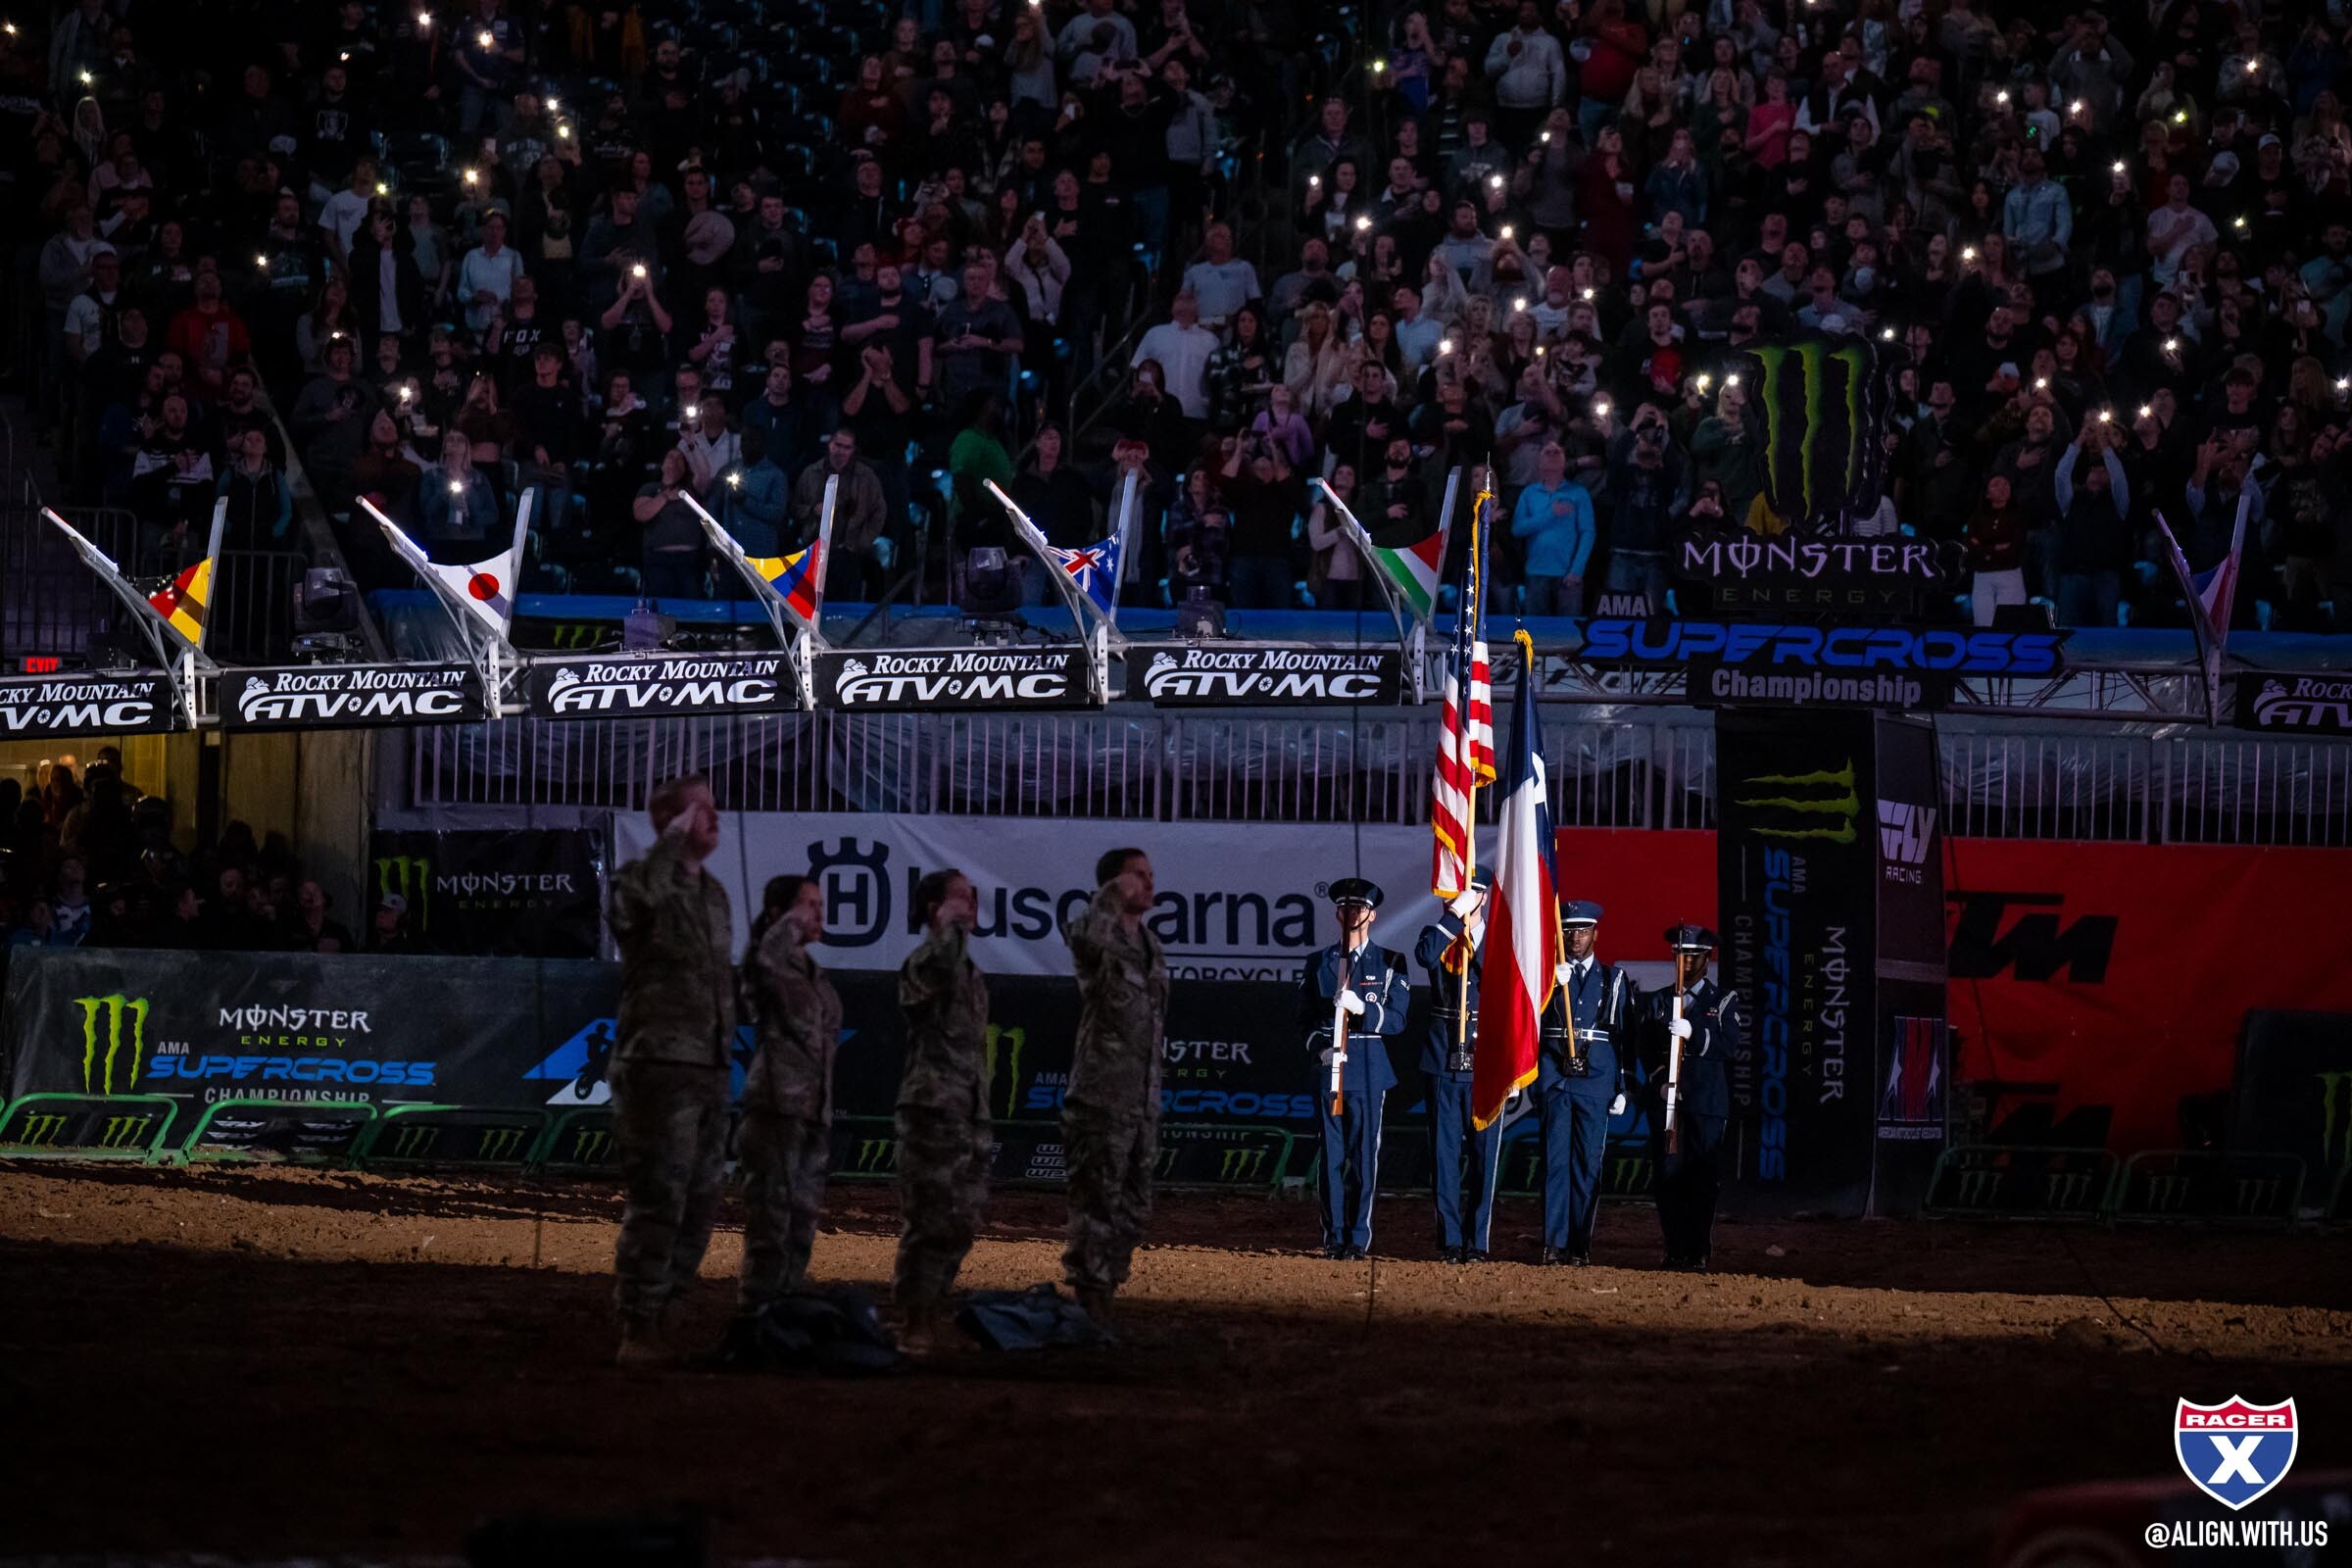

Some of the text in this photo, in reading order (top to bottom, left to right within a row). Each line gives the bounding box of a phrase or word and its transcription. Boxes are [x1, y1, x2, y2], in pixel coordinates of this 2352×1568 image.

[504, 328, 542, 344] FOX
[1682, 535, 1936, 579] MONSTER
[1593, 594, 1648, 617] AMA
[1721, 588, 1897, 605] ENERGY
[1579, 618, 2061, 674] SUPERCROSS
[583, 660, 780, 683] ROCKY MOUNTAIN
[872, 653, 1070, 674] ROCKY MOUNTAIN
[1182, 650, 1385, 671] ROCKY MOUNTAIN
[0, 682, 156, 704] CKY MOUNTAIN
[272, 669, 466, 693] ROCKY MOUNTAIN
[1711, 668, 1922, 708] Championship
[2291, 677, 2352, 700] ROCK
[1877, 799, 1937, 864] FLY
[435, 869, 576, 897] MONSTER
[1792, 856, 1807, 894] AMA
[1886, 865, 1922, 884] RACING
[457, 900, 555, 910] ENERGY
[1946, 891, 2118, 984] TM
[219, 1003, 372, 1034] MONSTER
[1732, 913, 1755, 1106] CHAMPIONSHIP
[1758, 847, 1793, 1182] SUPERCROSS
[1801, 953, 1814, 1077] ENERGY
[1818, 925, 1851, 1104] MONSTER
[157, 1041, 190, 1055] AMA
[240, 1035, 347, 1049] ENERGY
[145, 1054, 438, 1086] SUPERCROSS
[204, 1086, 370, 1104] CHAMPIONSHIP
